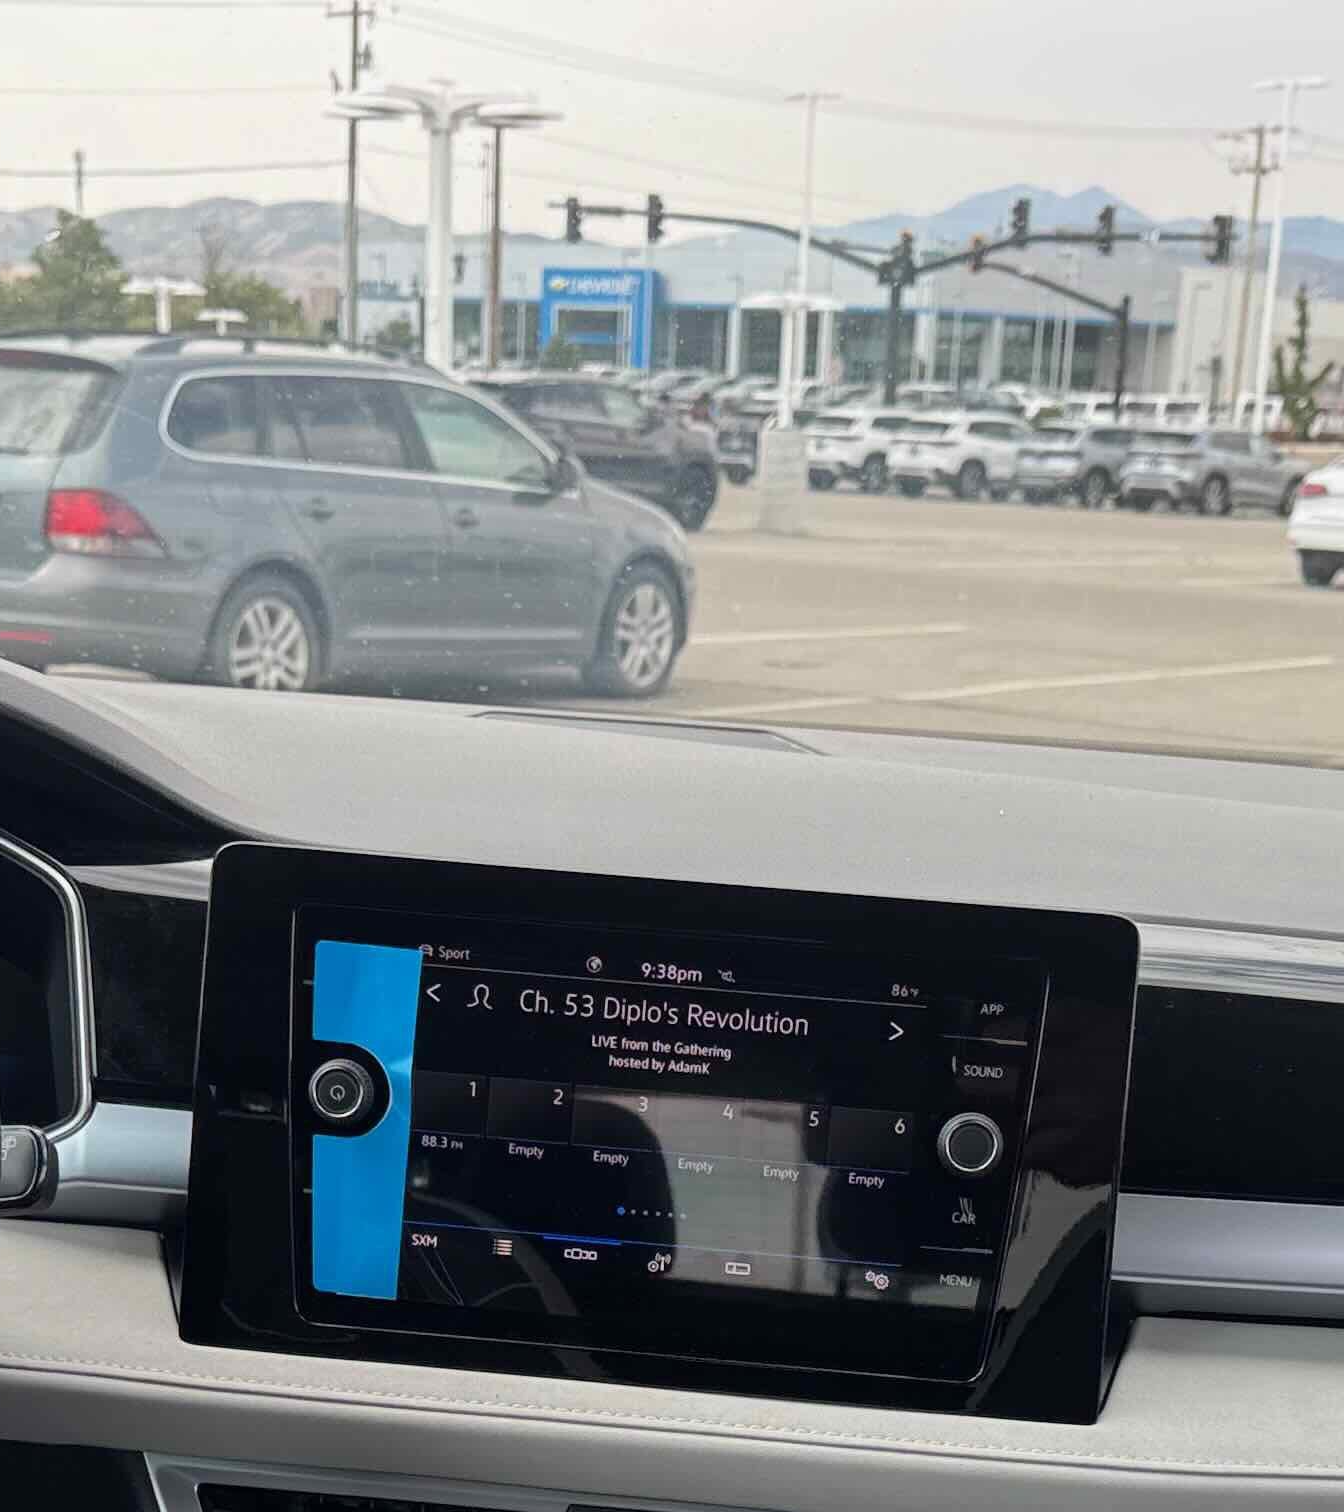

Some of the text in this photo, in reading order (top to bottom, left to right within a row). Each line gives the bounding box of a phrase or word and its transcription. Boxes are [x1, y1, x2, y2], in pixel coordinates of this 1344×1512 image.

[438, 945, 470, 961] Sport
[641, 962, 703, 984] 9:38pm
[519, 989, 810, 1036] Ch. 53 Diplo's Revolution
[979, 1003, 1005, 1016] APP
[591, 1034, 732, 1062] LIVE from the Gathering
[608, 1054, 711, 1075] hosted by AdamK
[963, 1064, 1003, 1079] SOUND
[468, 1080, 477, 1097] 1
[552, 1089, 564, 1105] 2
[638, 1096, 649, 1112] 3
[722, 1103, 735, 1120] 4
[808, 1110, 820, 1127] 5
[894, 1117, 906, 1135] 6
[421, 1134, 448, 1148] 88.3
[508, 1143, 545, 1160] Empty
[593, 1150, 629, 1167] Empty
[677, 1158, 714, 1175] Empty
[763, 1165, 800, 1182] Empty
[848, 1172, 885, 1189] Empty
[951, 1211, 976, 1225] CAR
[411, 1234, 438, 1248] SXM
[939, 1273, 973, 1288] MENU
